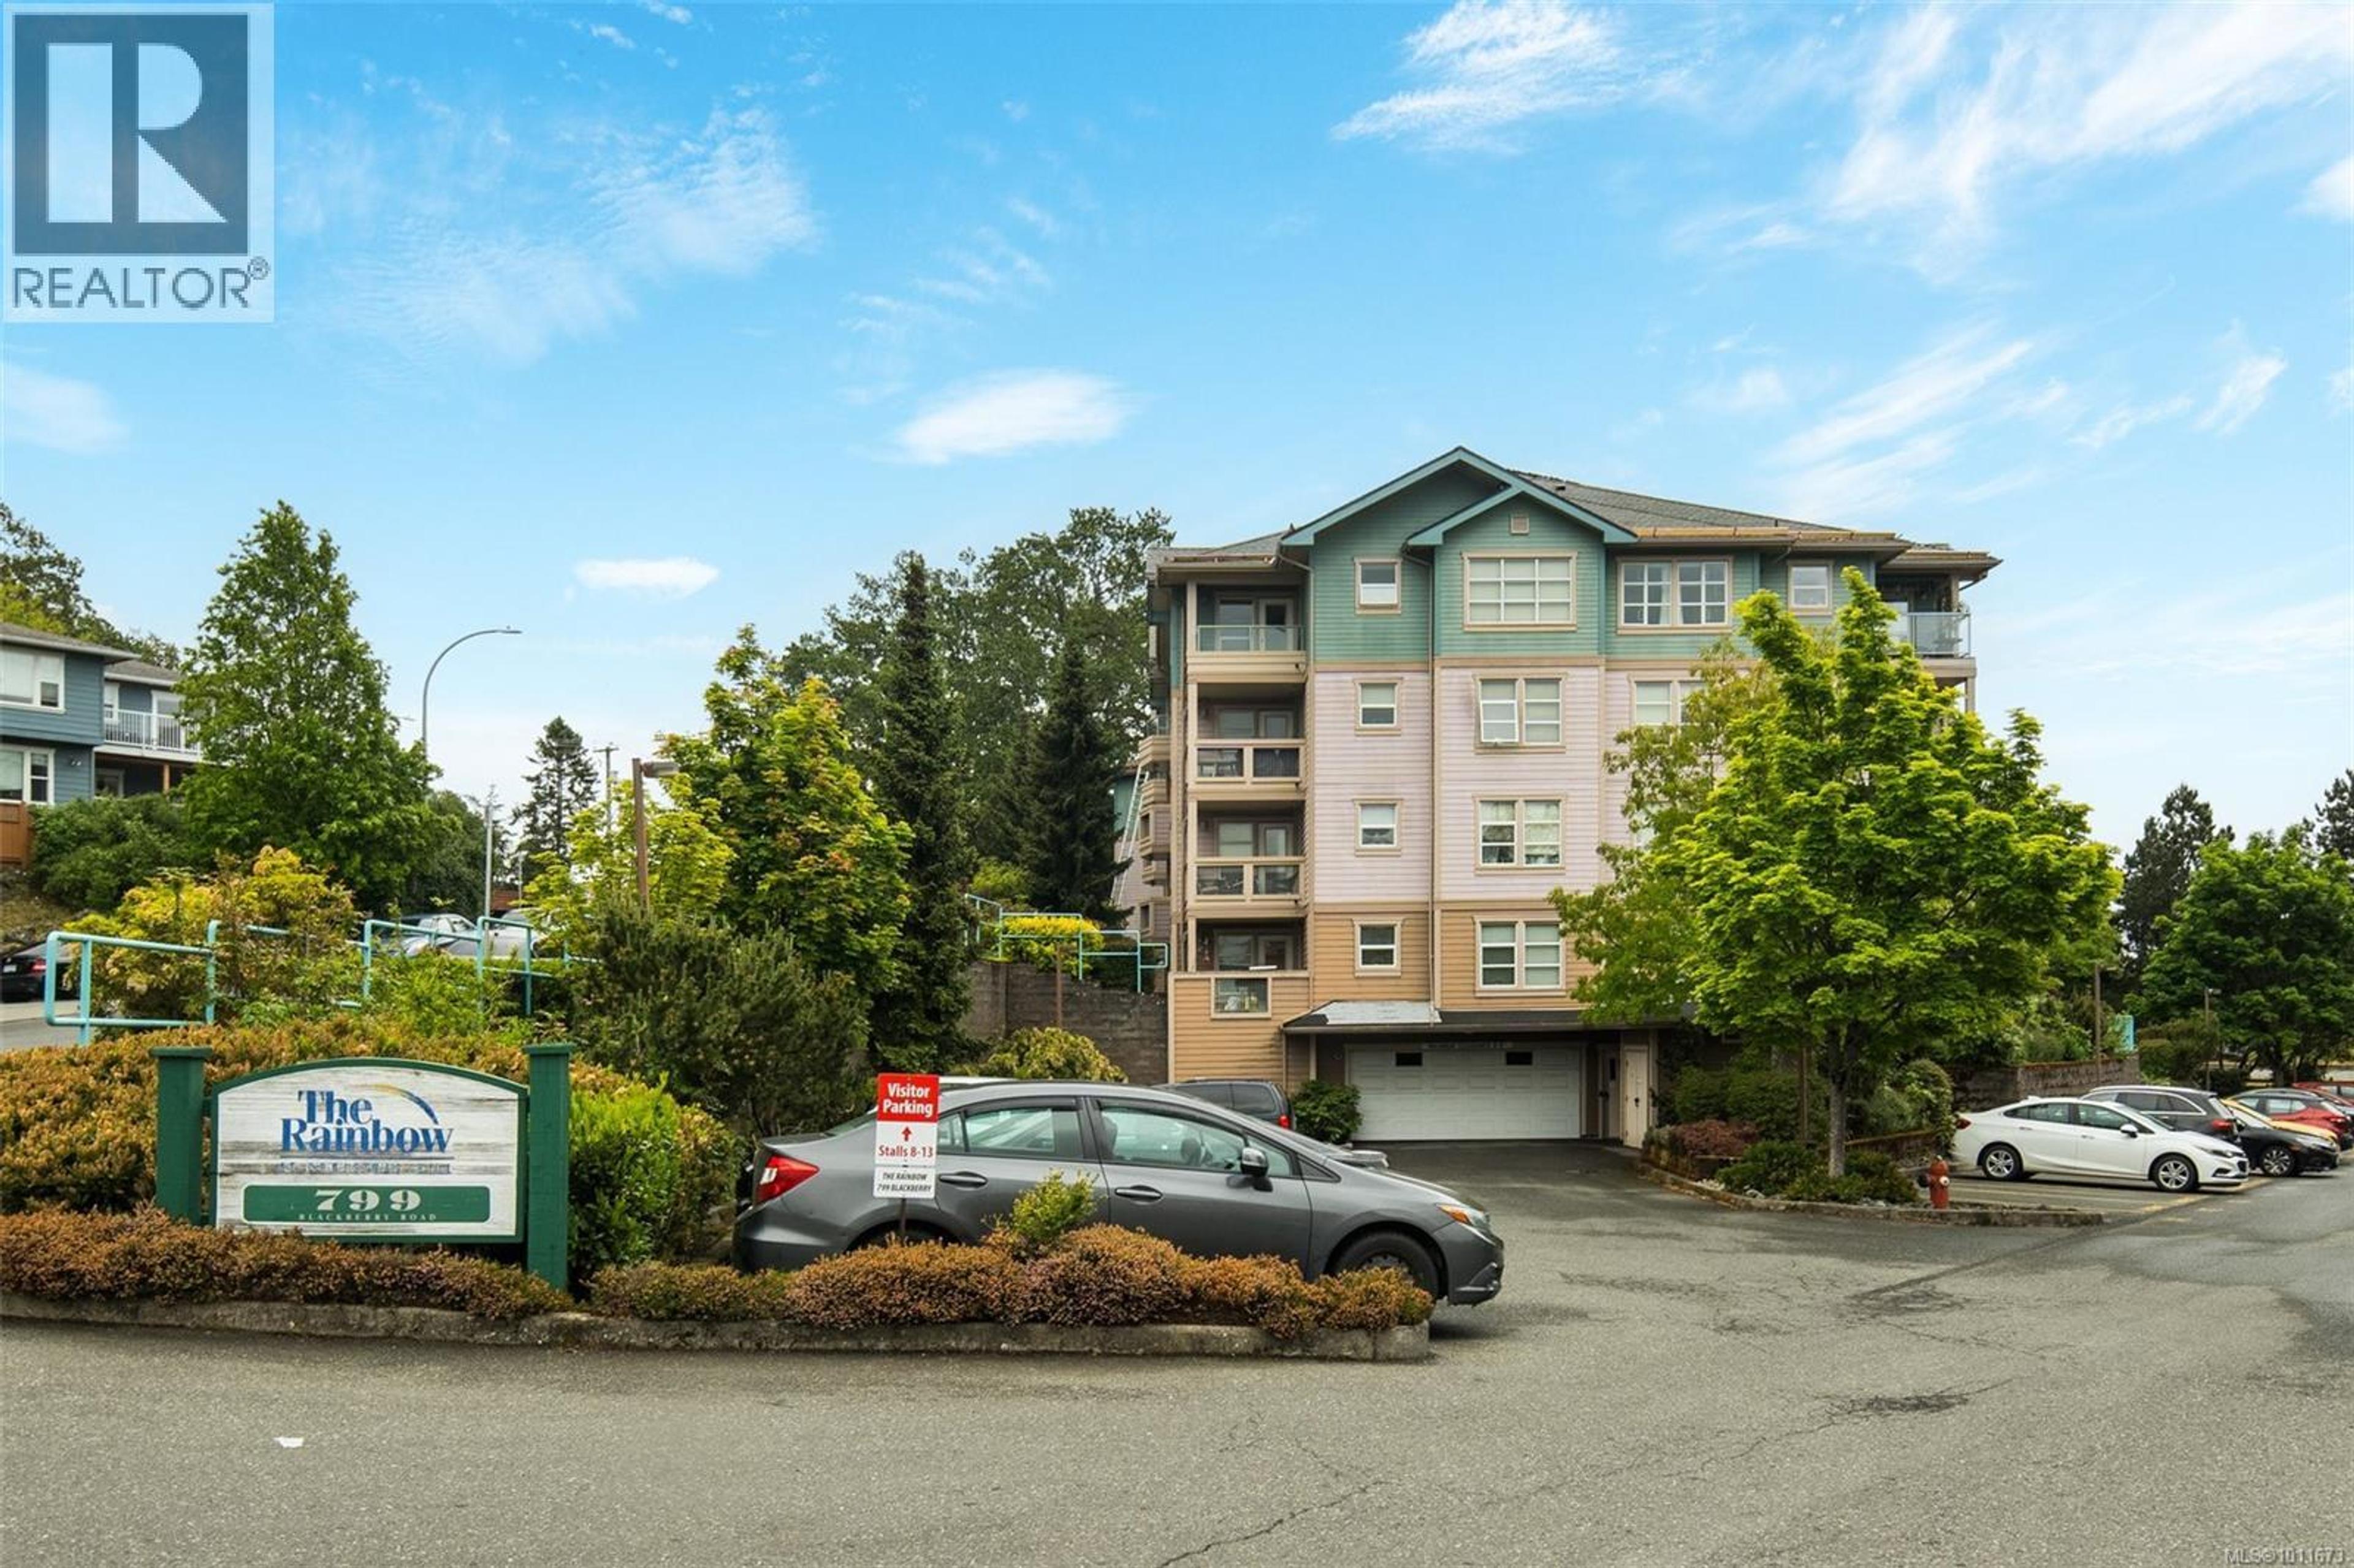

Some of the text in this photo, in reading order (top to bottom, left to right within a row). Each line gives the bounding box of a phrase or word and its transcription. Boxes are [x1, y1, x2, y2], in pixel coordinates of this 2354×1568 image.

[888, 1083, 930, 1098] Visitor
[298, 1090, 373, 1125] The
[883, 1099, 933, 1117] Parking
[281, 1117, 454, 1154] Rainbow
[878, 1144, 933, 1157] Stalls 8-13
[891, 1184, 931, 1192] BLACKBERRY
[314, 1189, 421, 1211] 799
